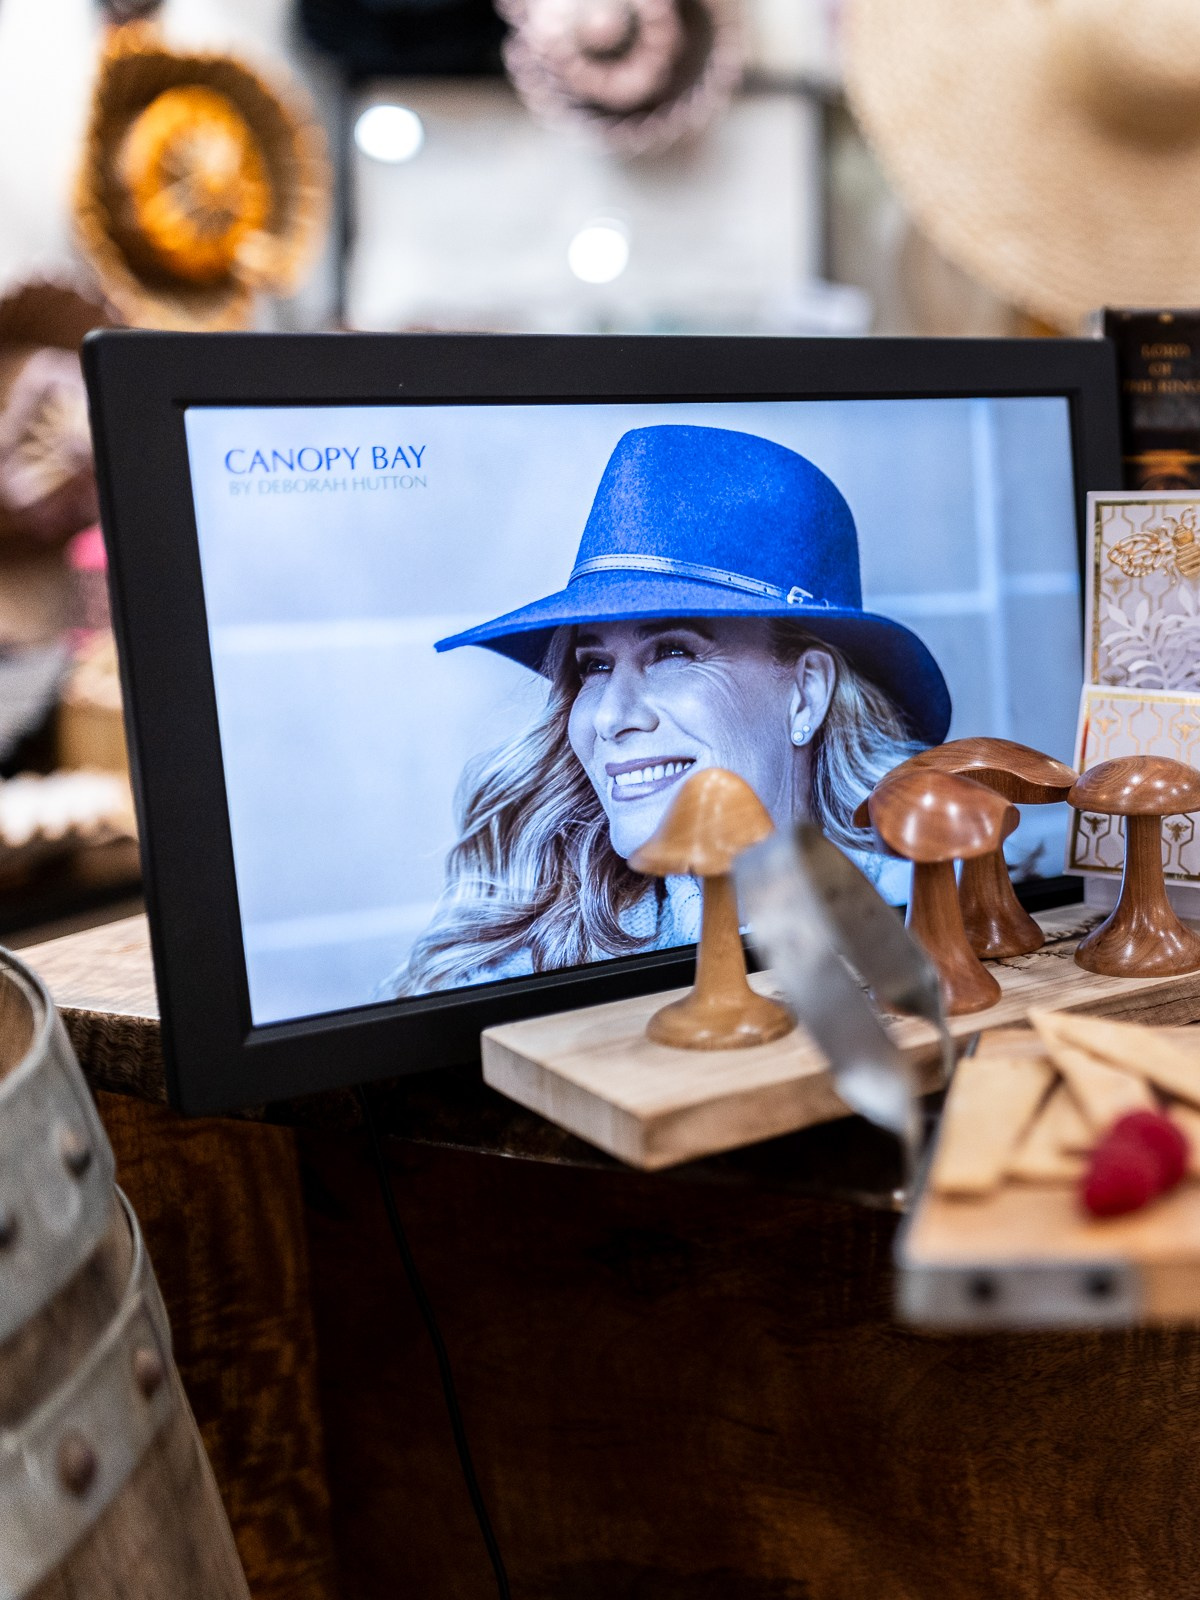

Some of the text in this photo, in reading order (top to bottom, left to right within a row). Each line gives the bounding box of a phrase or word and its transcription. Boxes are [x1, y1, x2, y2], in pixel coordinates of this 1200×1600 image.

[224, 444, 426, 474] CANOPY BAY
[229, 474, 428, 496] BY DEBORAH HUTTON
